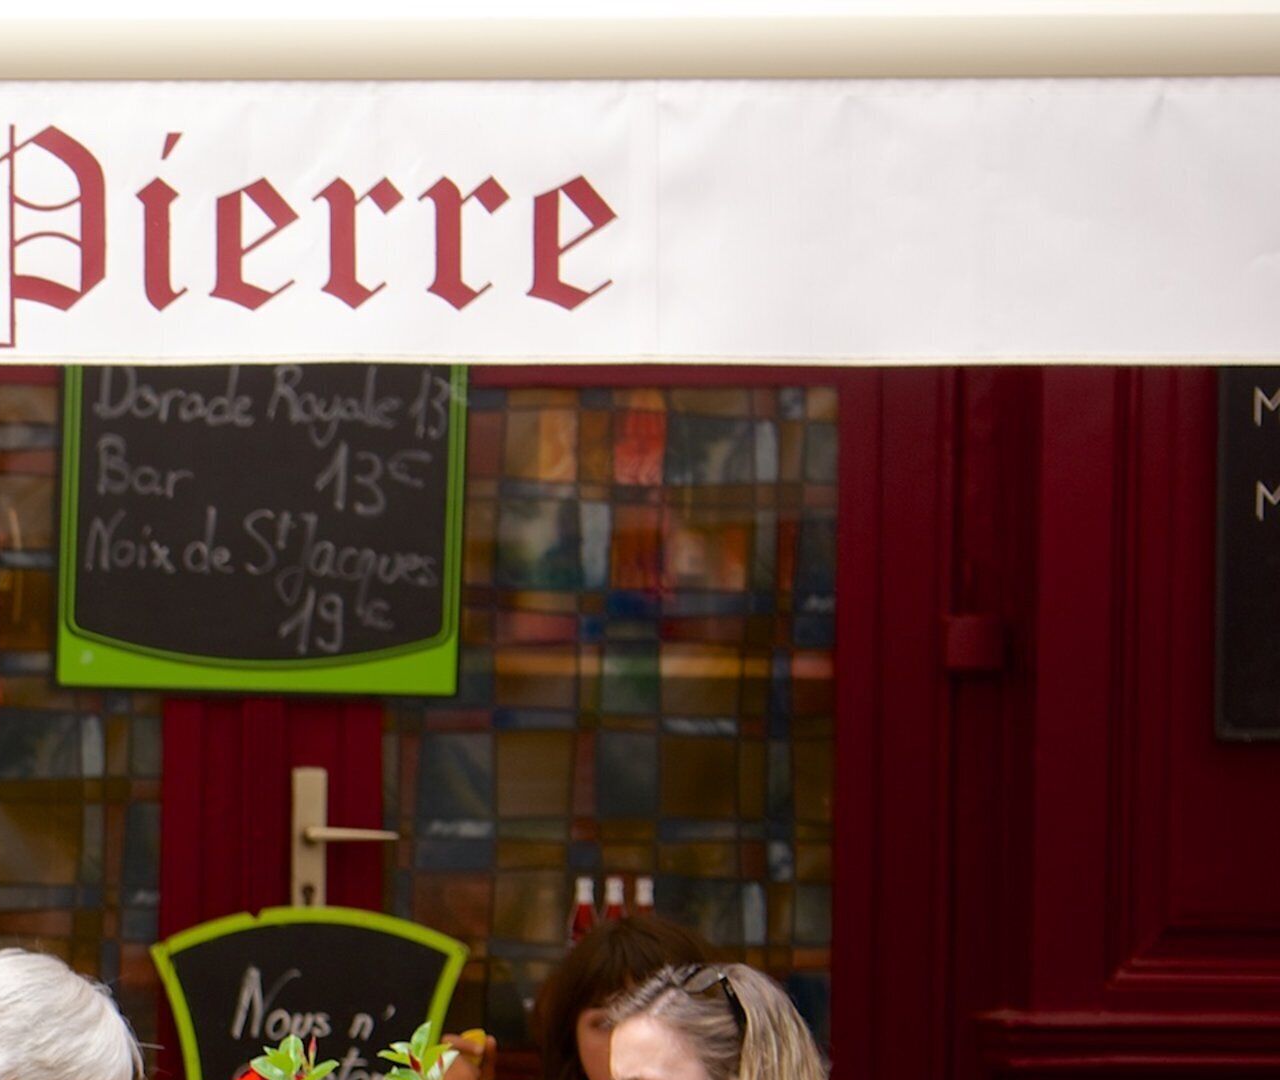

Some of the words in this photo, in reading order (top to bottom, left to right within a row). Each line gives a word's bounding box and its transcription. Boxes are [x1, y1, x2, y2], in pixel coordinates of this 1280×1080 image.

[93, 364, 255, 428] Dorade
[266, 364, 402, 448] Royale
[96, 432, 195, 498] Bar
[85, 508, 176, 575] Noix
[182, 505, 236, 575] de
[230, 964, 332, 1040] Nous
